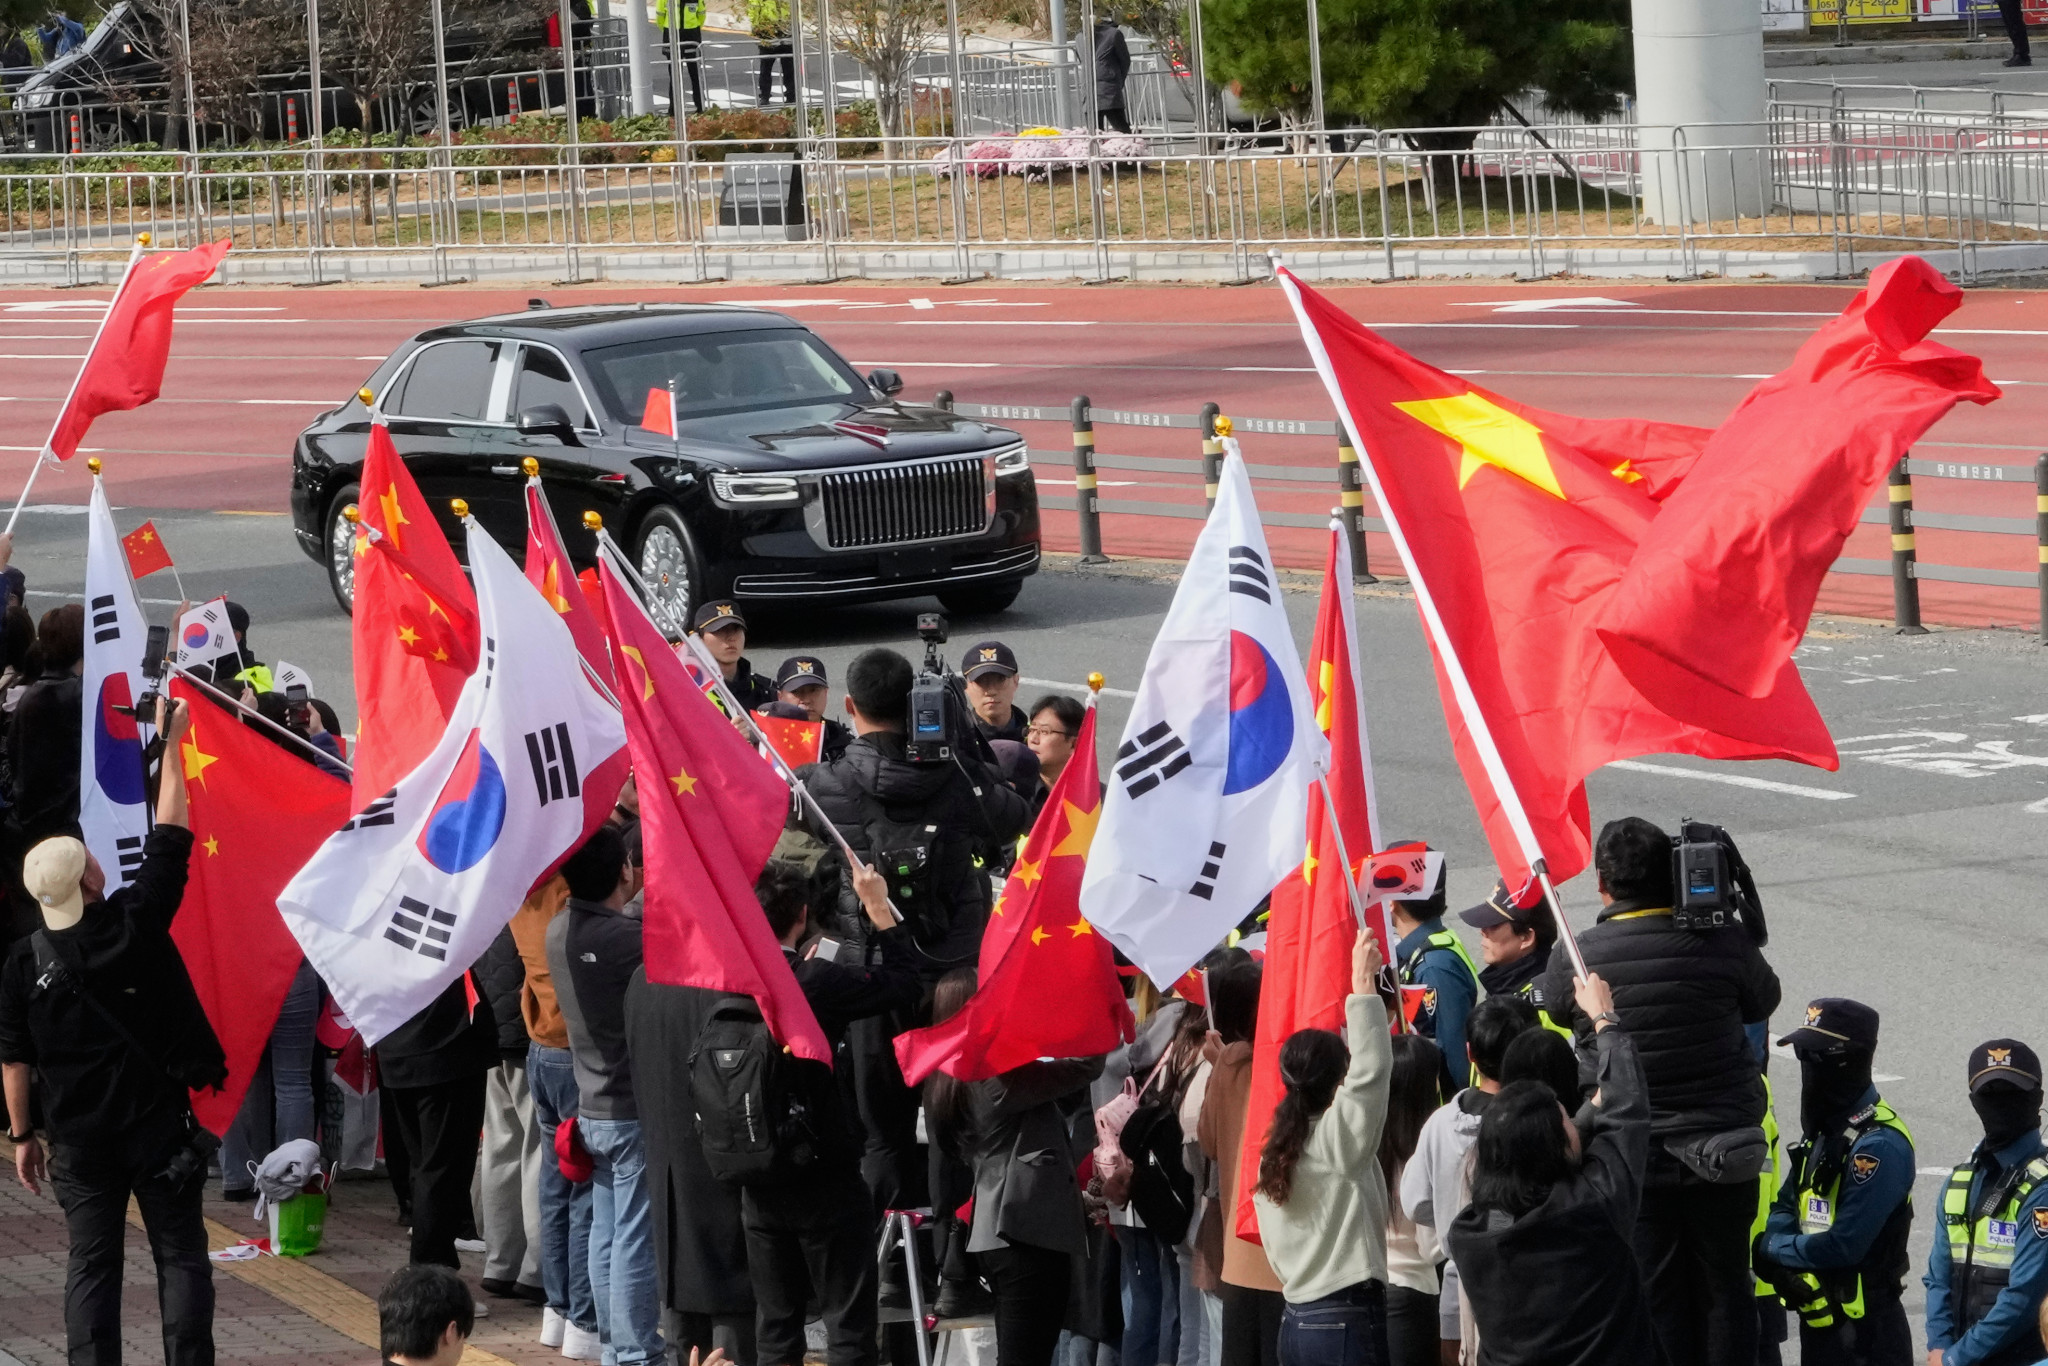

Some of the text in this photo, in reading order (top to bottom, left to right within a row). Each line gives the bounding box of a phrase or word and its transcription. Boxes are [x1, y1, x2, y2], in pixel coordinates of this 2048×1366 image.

[1937, 463, 2003, 480] 무단횡단금지
[1810, 1213, 1827, 1221] POLICE
[1990, 1235, 2016, 1244] POLICE
